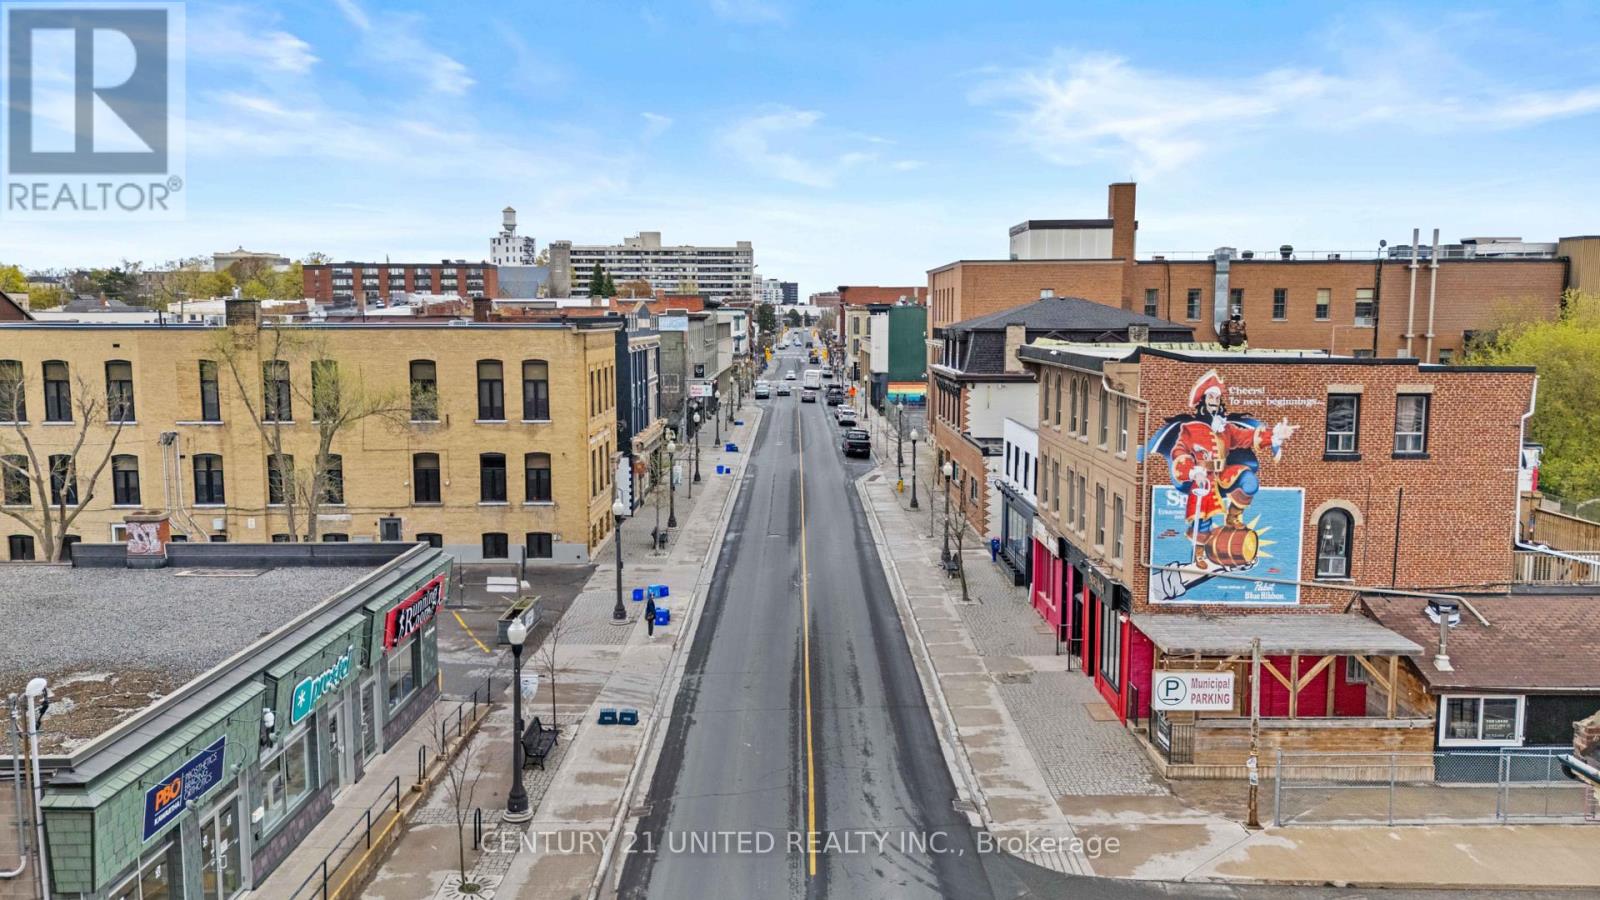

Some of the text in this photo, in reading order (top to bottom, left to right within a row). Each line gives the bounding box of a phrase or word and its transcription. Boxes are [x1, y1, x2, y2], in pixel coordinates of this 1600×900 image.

[1228, 386, 1265, 396] Cheers!
[1229, 396, 1241, 406] To
[1165, 680, 1179, 697] P
[1190, 677, 1231, 692] Municipal
[1190, 692, 1231, 705] PARKING
